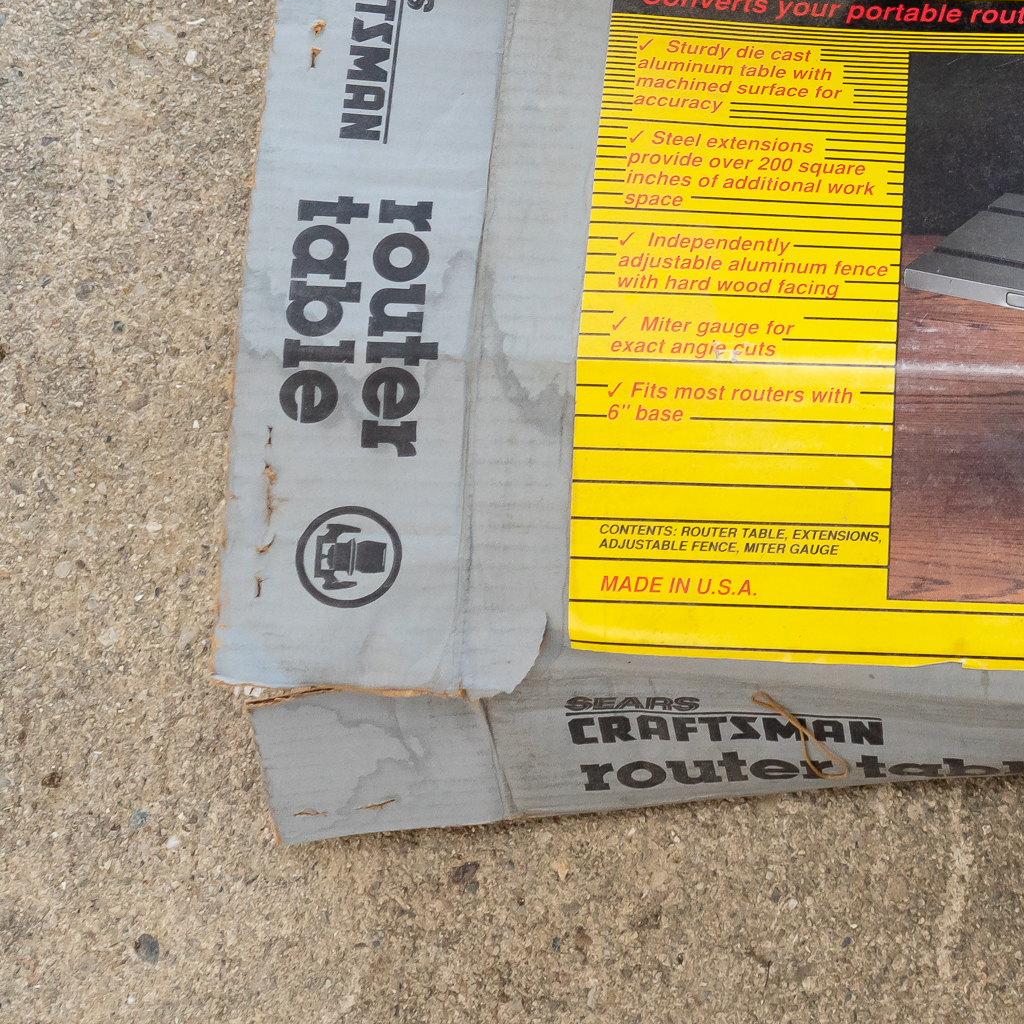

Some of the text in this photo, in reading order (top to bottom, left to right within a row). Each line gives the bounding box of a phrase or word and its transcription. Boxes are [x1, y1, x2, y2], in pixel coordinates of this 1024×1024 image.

[776, 0, 841, 20] your
[846, 3, 962, 24] portable
[666, 39, 812, 63] Sturdy die cast
[637, 57, 832, 81] aluminum table with
[636, 76, 843, 100] machined surface for
[633, 93, 723, 114] accuracy
[651, 131, 814, 154] Steel extensions
[627, 152, 866, 177] provide over 200 square
[626, 170, 876, 196] inches of additional work
[624, 191, 683, 209] space
[648, 232, 791, 256] Independently
[617, 254, 888, 277] adjustable aluminum fence
[617, 274, 840, 299] with hard wood facing
[279, 196, 370, 423] table
[360, 199, 439, 457] router
[640, 316, 795, 337] Miter gauge for
[610, 339, 665, 354] exact
[733, 341, 776, 357] cuts
[630, 381, 853, 404] Fits most routers with
[636, 405, 683, 423] base
[599, 524, 882, 544] CONTENTS: ROUTER TABLE, EXTENSIONS,
[599, 539, 839, 556] ADJUSTABLE FENCE, MITER GAUGE
[600, 575, 757, 596] MADE IN U.S.A.
[564, 696, 700, 711] SEARS
[567, 715, 884, 745] CRAFTSMAN
[580, 751, 834, 791] router
